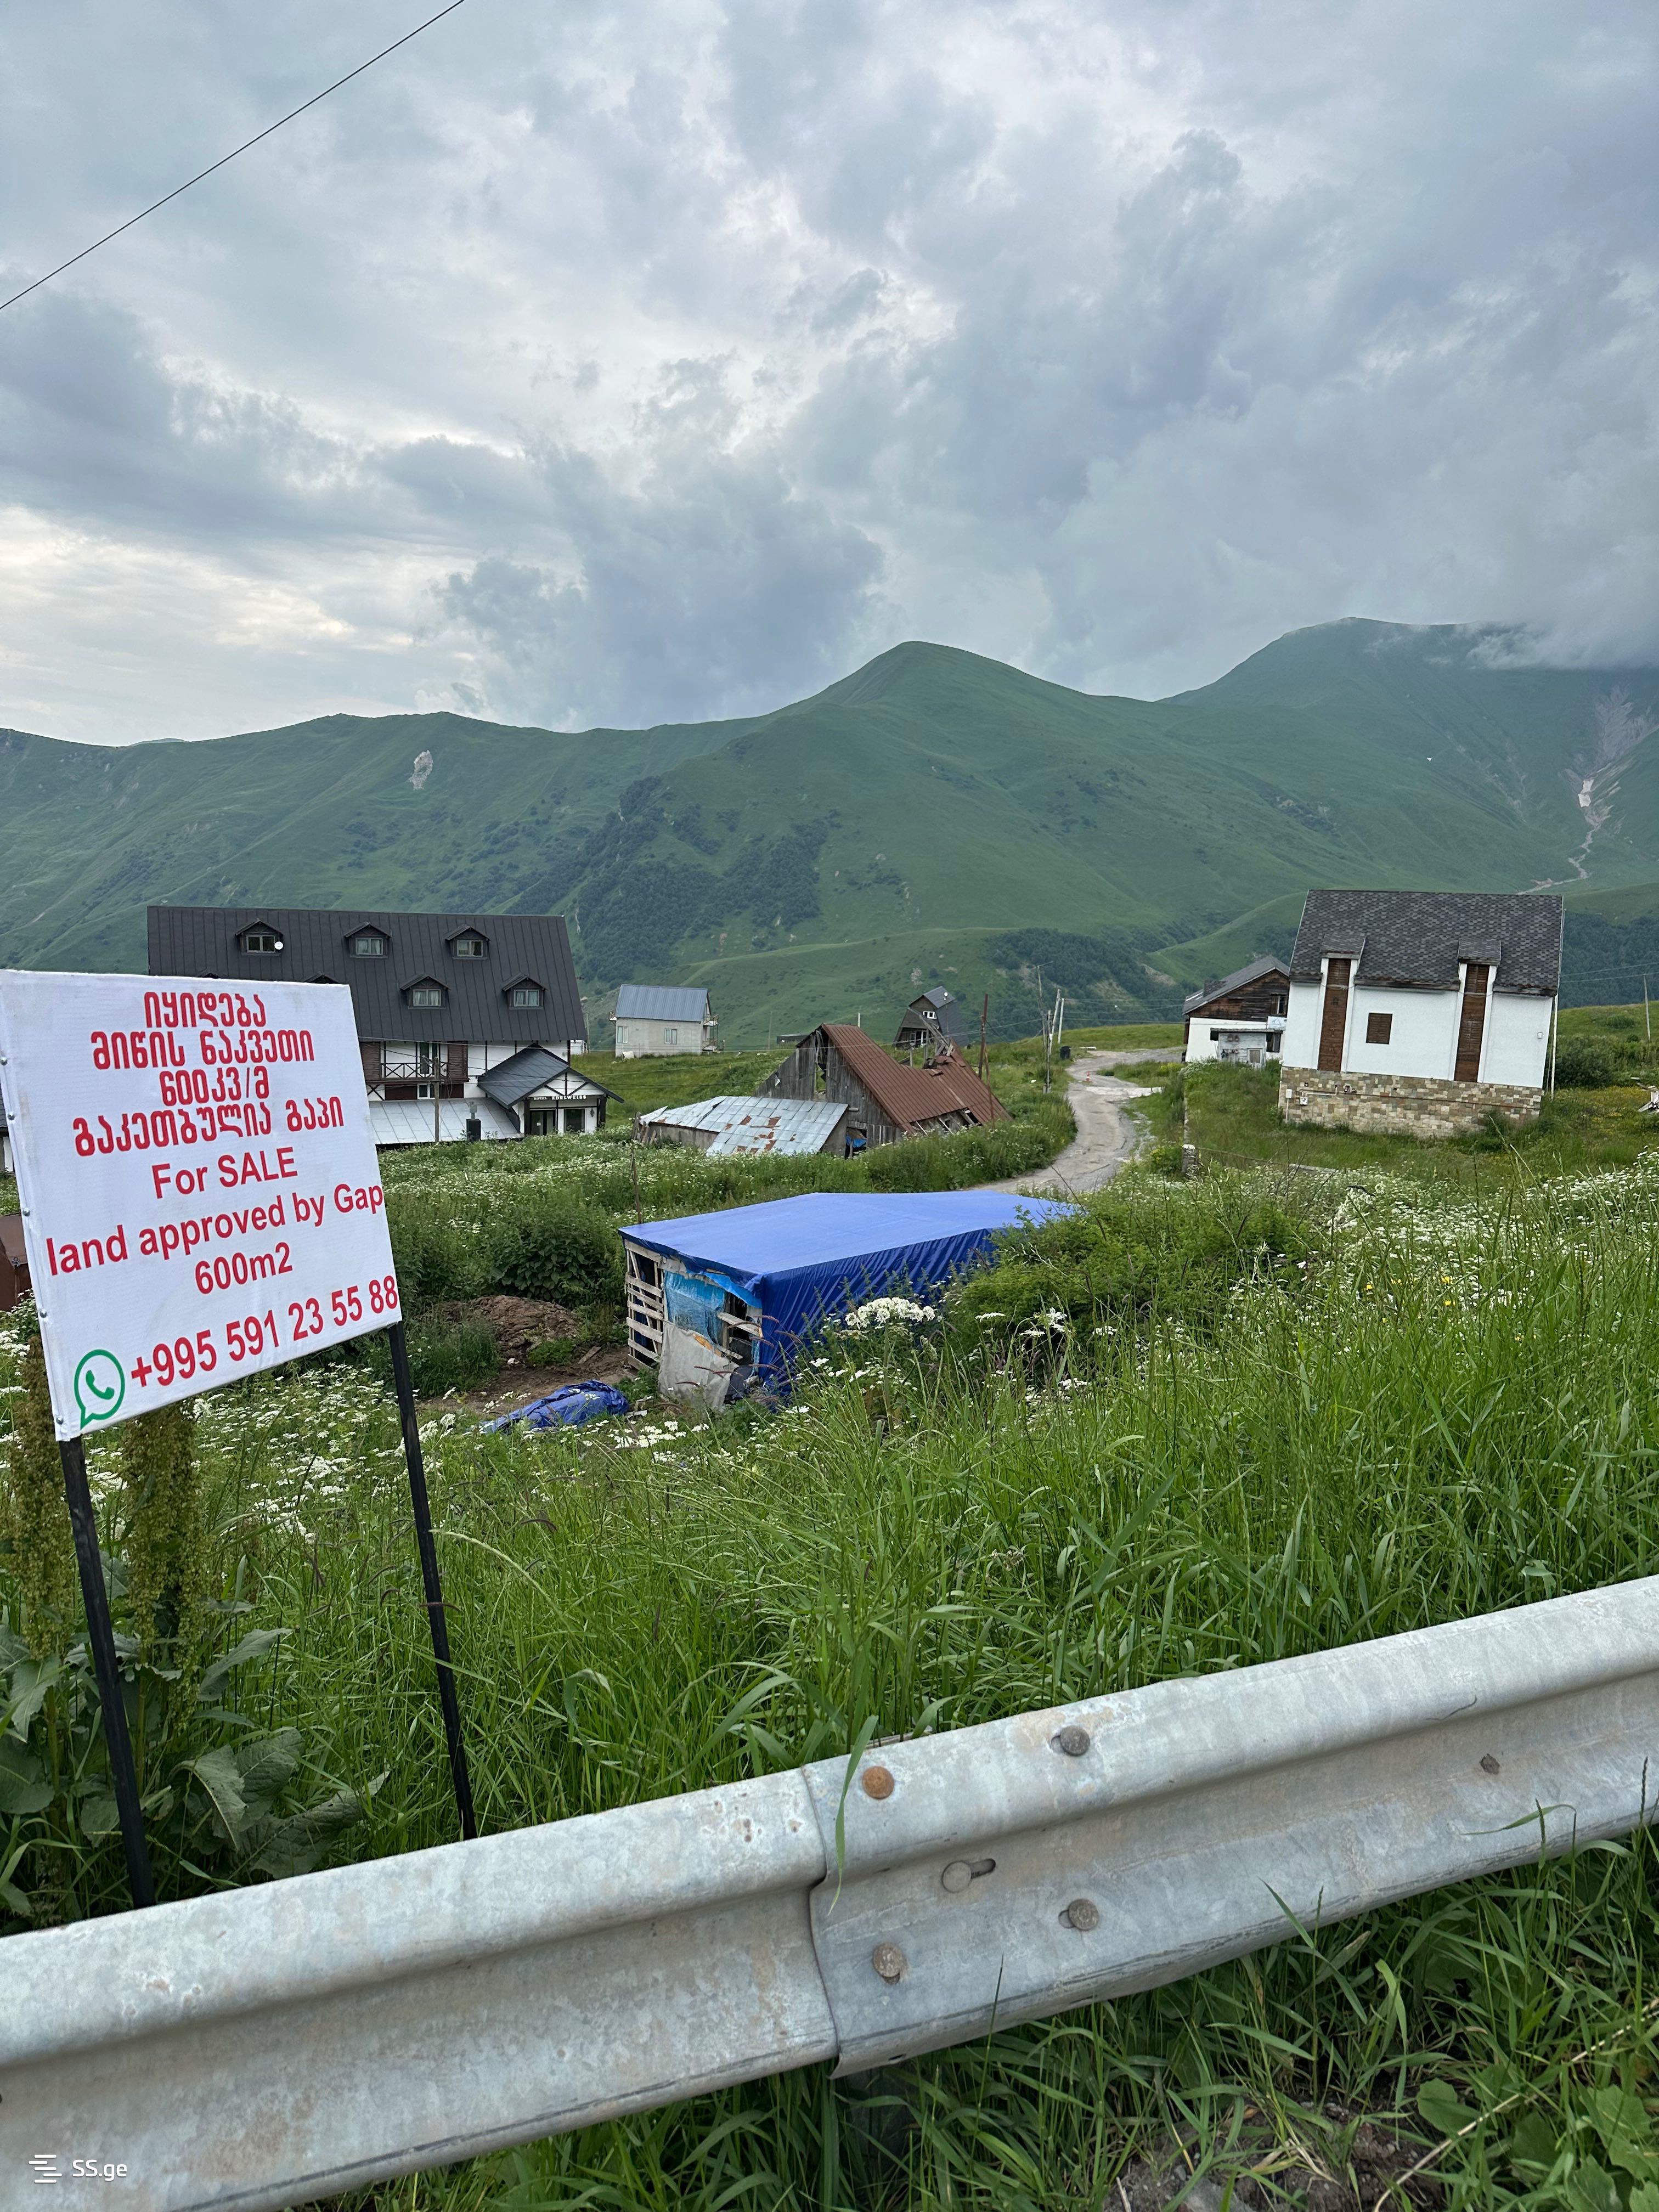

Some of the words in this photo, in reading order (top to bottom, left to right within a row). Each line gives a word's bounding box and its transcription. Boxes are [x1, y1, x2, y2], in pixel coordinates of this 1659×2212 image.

[144, 991, 267, 1028] იყიდება
[91, 1031, 185, 1070] მიწის
[199, 1029, 314, 1065] ნაკვეთი
[159, 1065, 270, 1107] 600კვ/მ
[72, 1102, 272, 1157] გაკეთბულია
[285, 1096, 344, 1132] გაპი
[151, 1163, 208, 1199] For
[217, 1147, 298, 1188] SALE
[46, 1224, 128, 1276] land
[139, 1195, 286, 1260] approved
[292, 1193, 325, 1227] by
[334, 1183, 383, 1214] Gap
[195, 1242, 293, 1295] 600m2
[131, 1329, 217, 1387] +995
[225, 1310, 279, 1361] 591
[288, 1297, 324, 1341] 23
[331, 1285, 363, 1326] 55
[368, 1275, 398, 1314] 88
